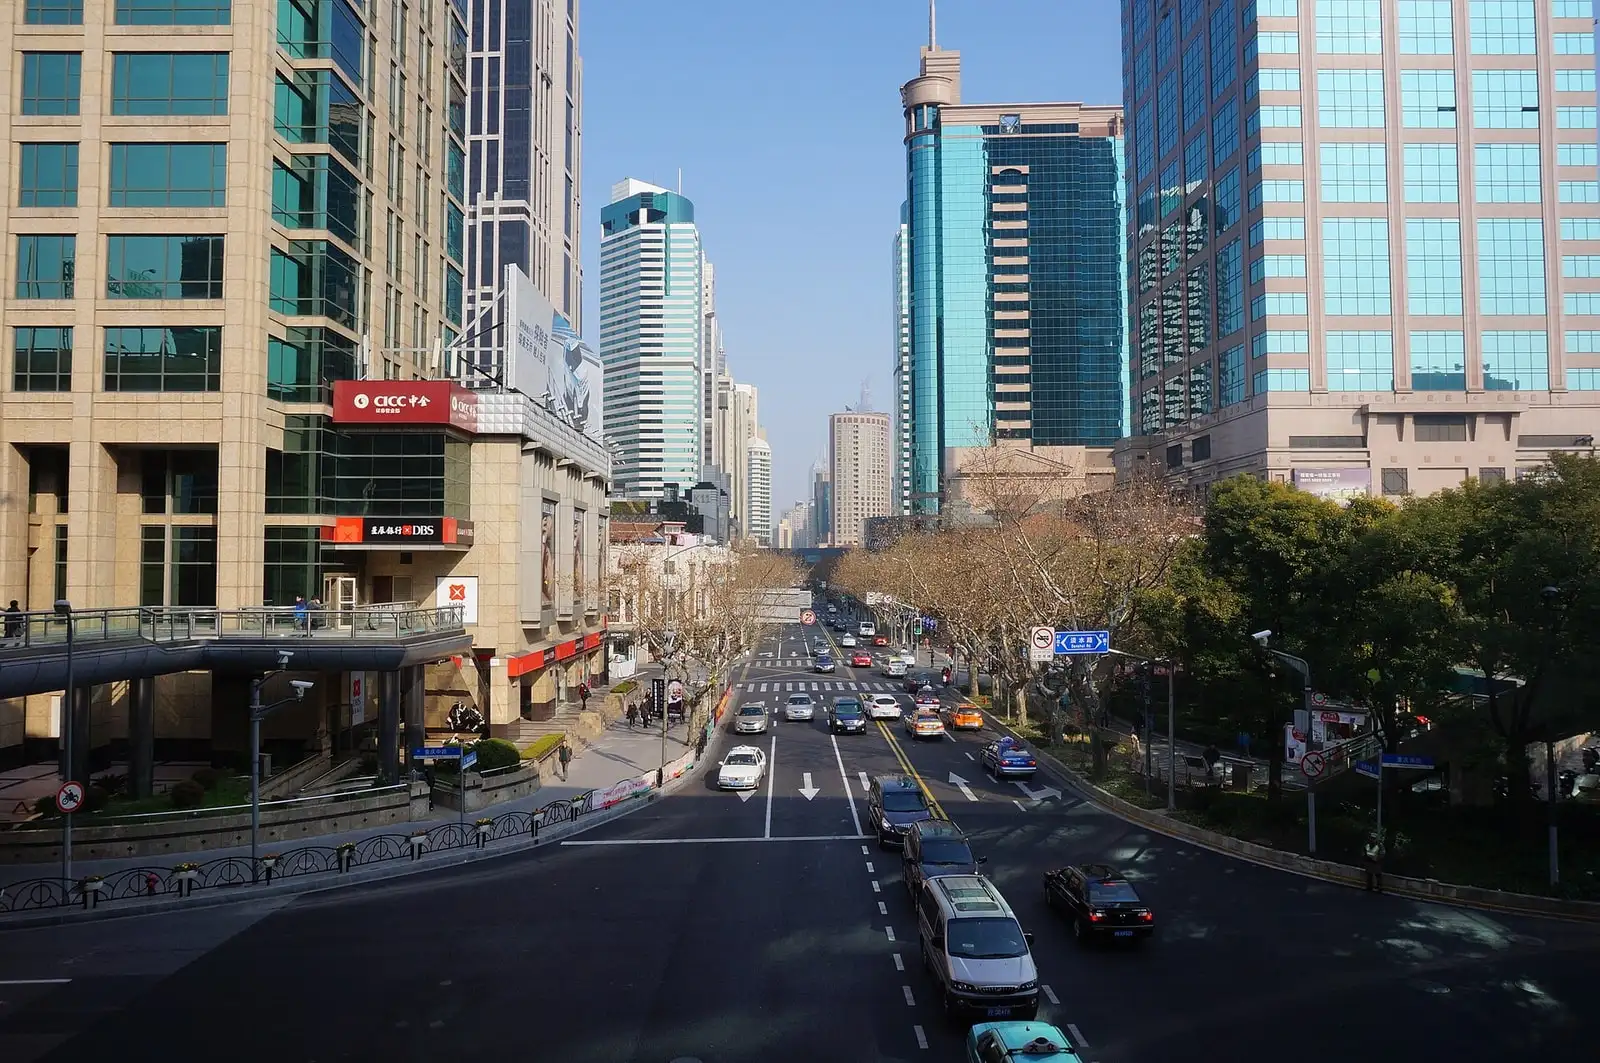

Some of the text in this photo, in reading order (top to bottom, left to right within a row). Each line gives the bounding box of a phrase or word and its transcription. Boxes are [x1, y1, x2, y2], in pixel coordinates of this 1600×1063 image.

[373, 394, 431, 408] CICC 中金
[371, 525, 434, 536] 星展银行 DBS
